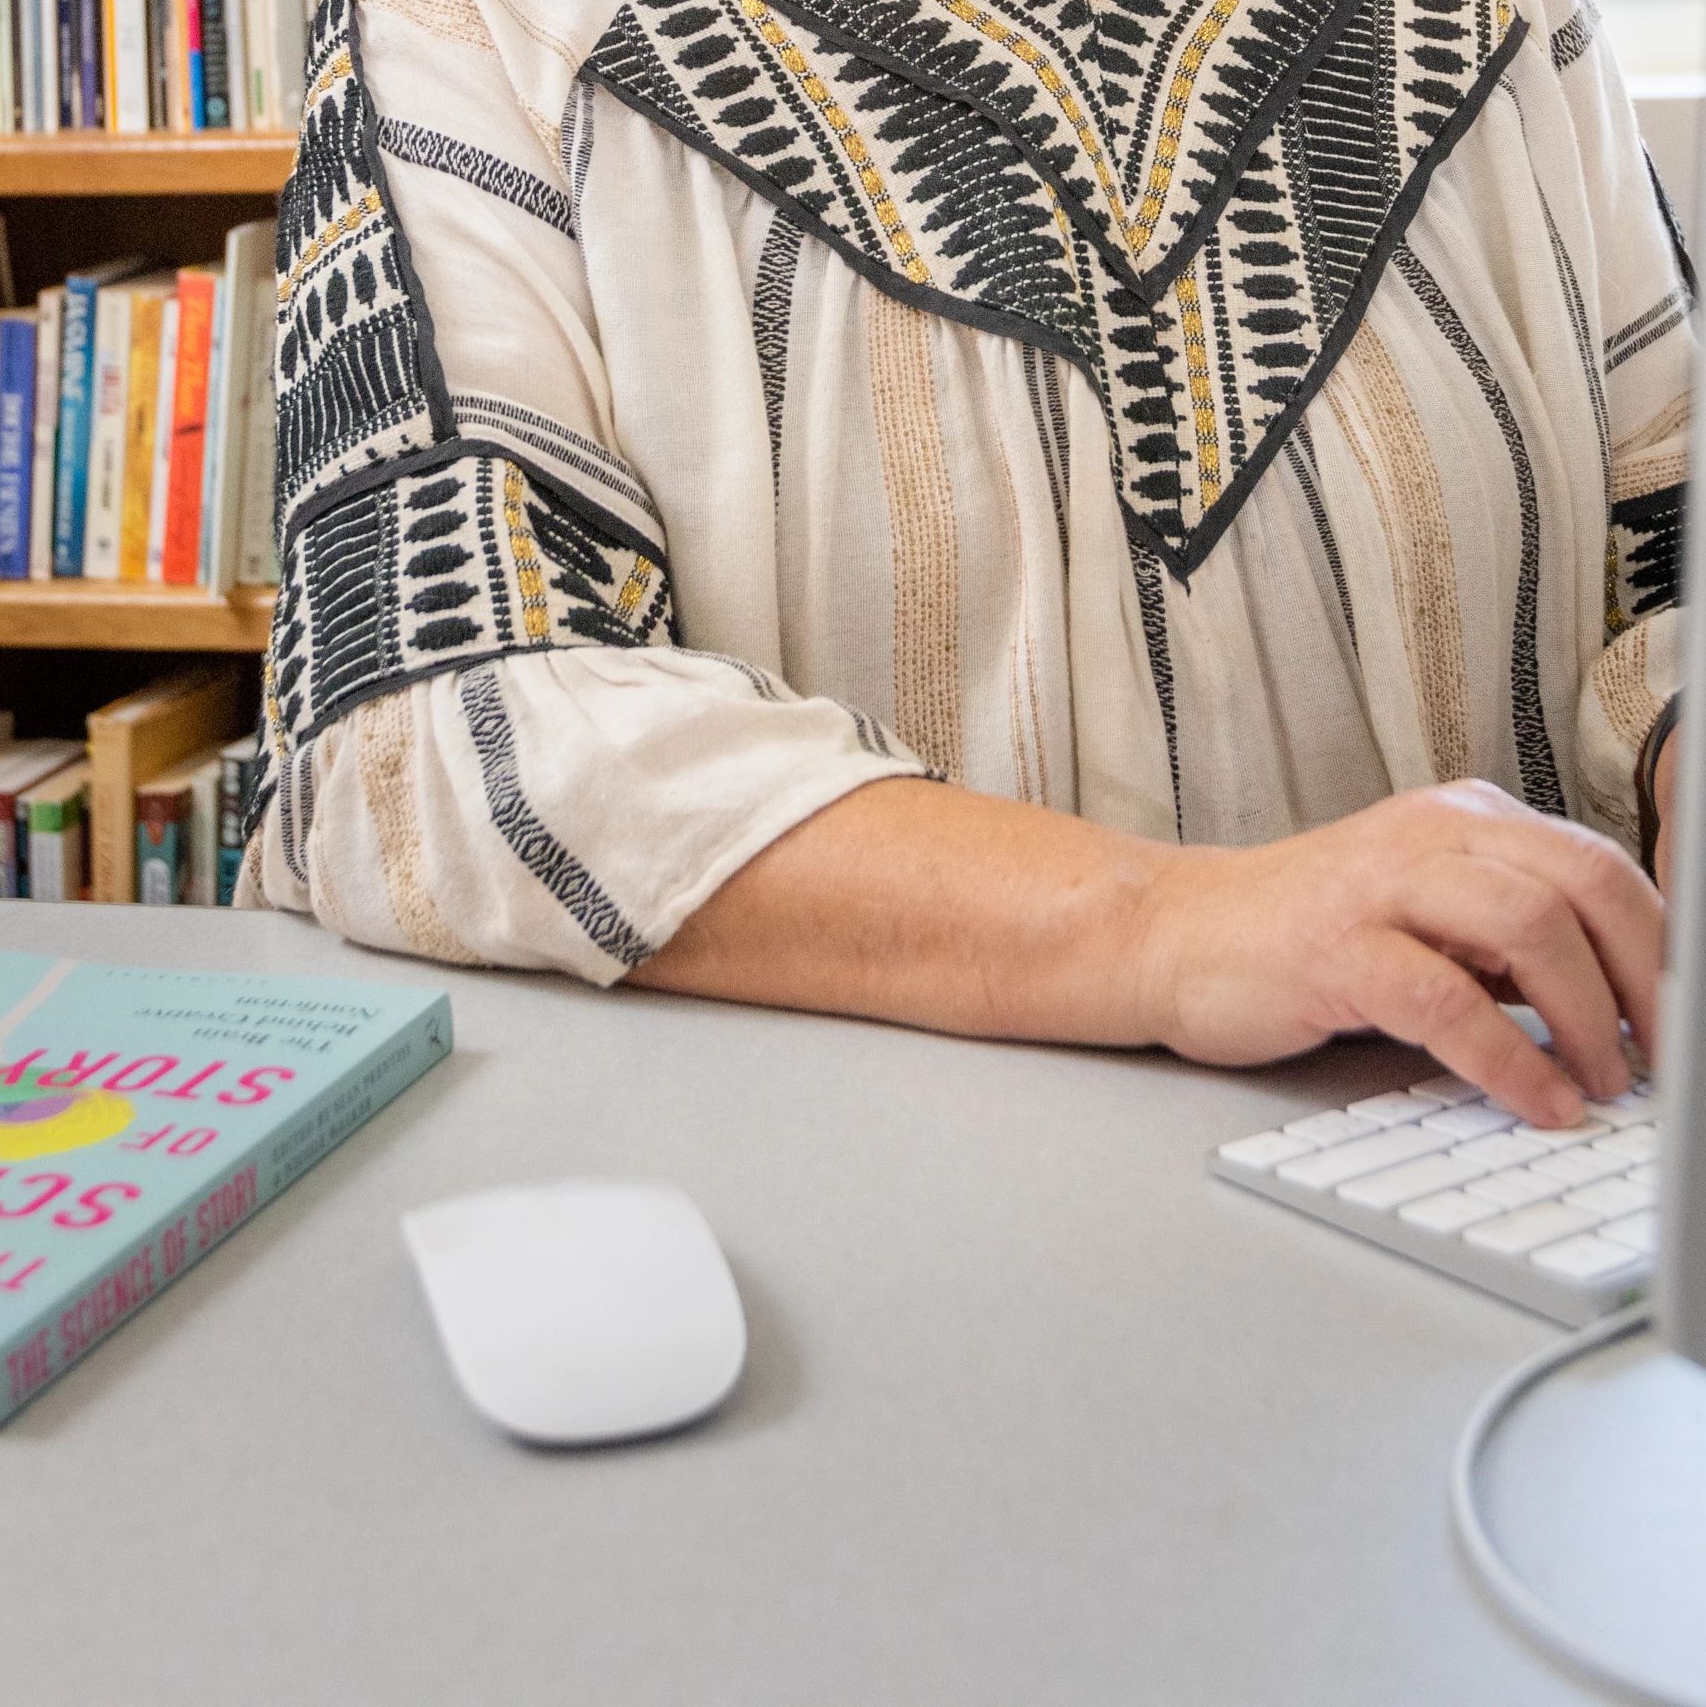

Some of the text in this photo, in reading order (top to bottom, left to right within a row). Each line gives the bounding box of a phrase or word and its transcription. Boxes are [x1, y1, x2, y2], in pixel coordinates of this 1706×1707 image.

[134, 1008, 359, 1037] Behind Creative
[193, 1028, 272, 1046] Brain
[117, 1122, 222, 1158] OF
[4, 1163, 263, 1402] THE SCIENCE OF STORY
